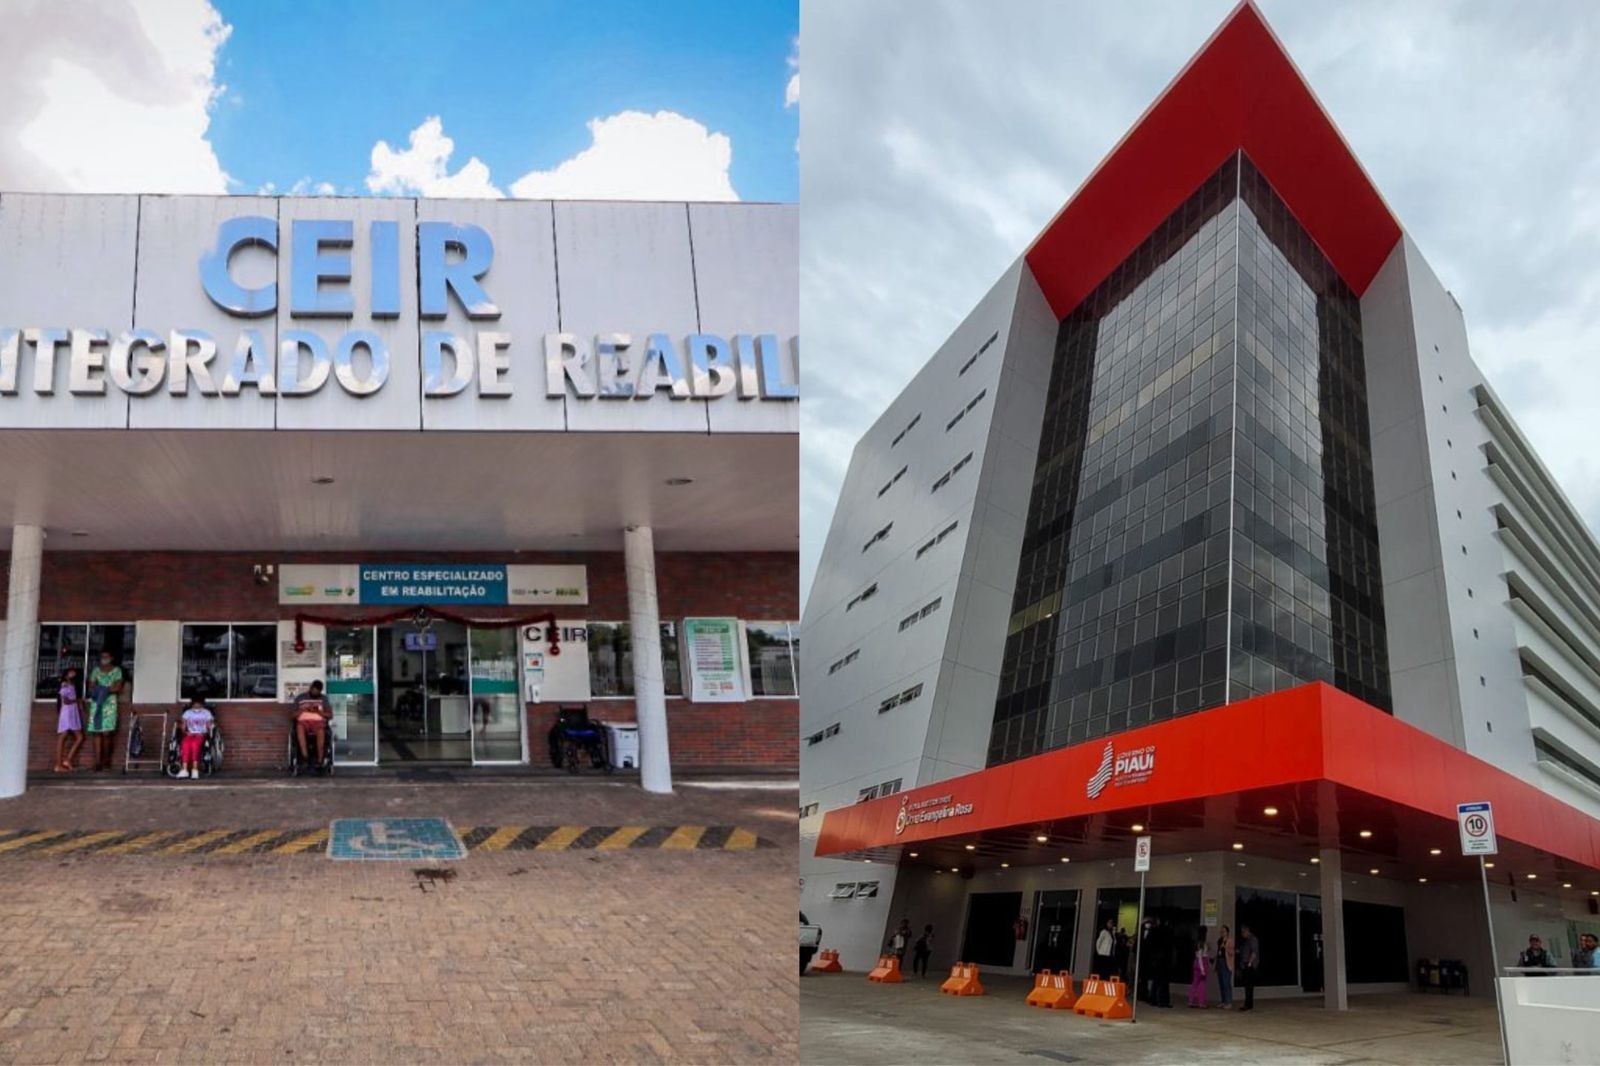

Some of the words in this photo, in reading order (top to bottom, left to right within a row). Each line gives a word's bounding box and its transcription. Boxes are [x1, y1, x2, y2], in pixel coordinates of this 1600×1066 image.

[199, 215, 502, 319] CEIR
[422, 330, 513, 399] DE
[544, 332, 799, 402] REABIL
[363, 571, 410, 581] CENTRO
[413, 571, 504, 581] ESPECIALIZADO
[381, 586, 399, 596] EM
[402, 585, 486, 598] REABILITAÇÃO
[1469, 818, 1484, 830] 10
